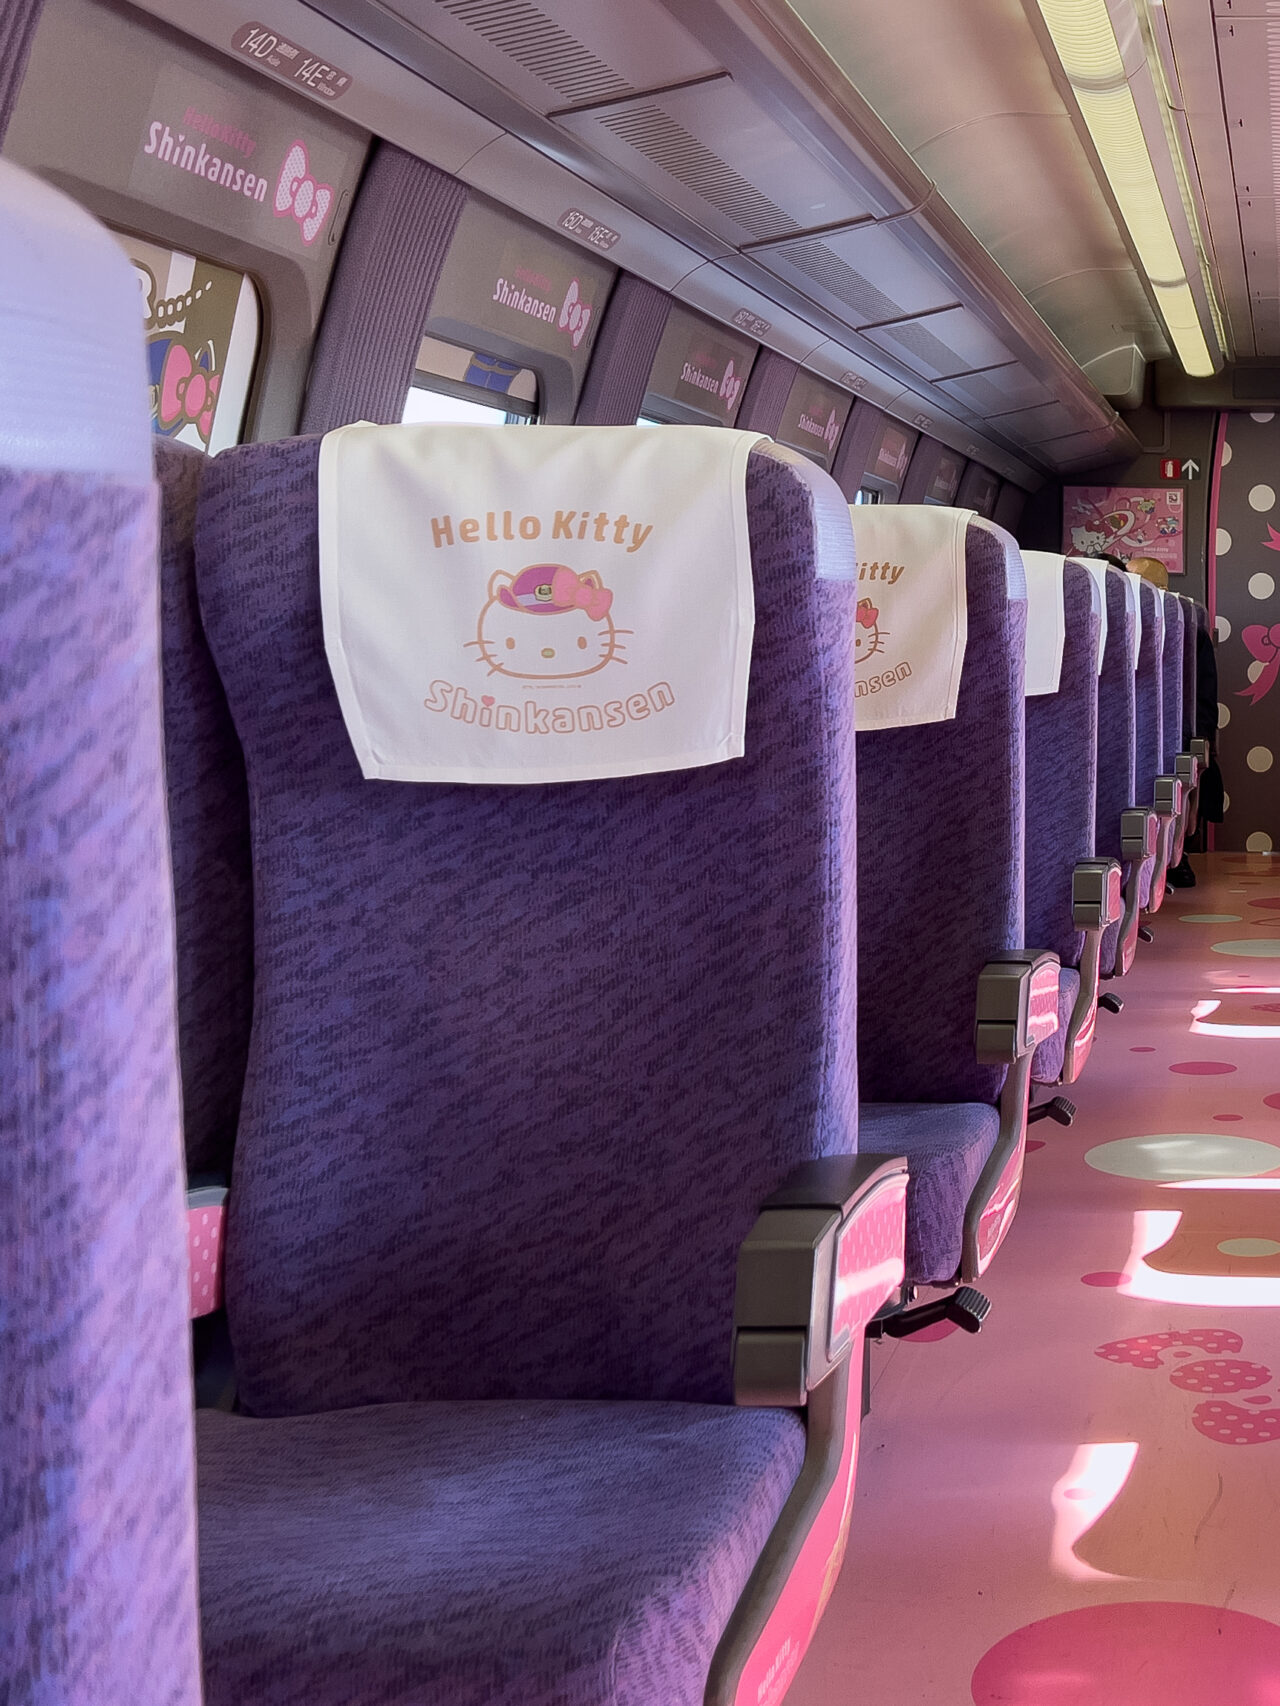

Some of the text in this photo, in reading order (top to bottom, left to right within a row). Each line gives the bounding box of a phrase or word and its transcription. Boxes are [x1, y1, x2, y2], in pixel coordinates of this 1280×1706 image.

[240, 28, 278, 58] 14D
[294, 58, 331, 87] 14E
[144, 121, 268, 202] Shinkansen
[493, 278, 556, 323] Shinkansen
[681, 362, 719, 393] Shinkansen
[430, 510, 653, 553] Hello Kitty
[855, 562, 905, 585] itty
[424, 679, 675, 734] Shinkansen
